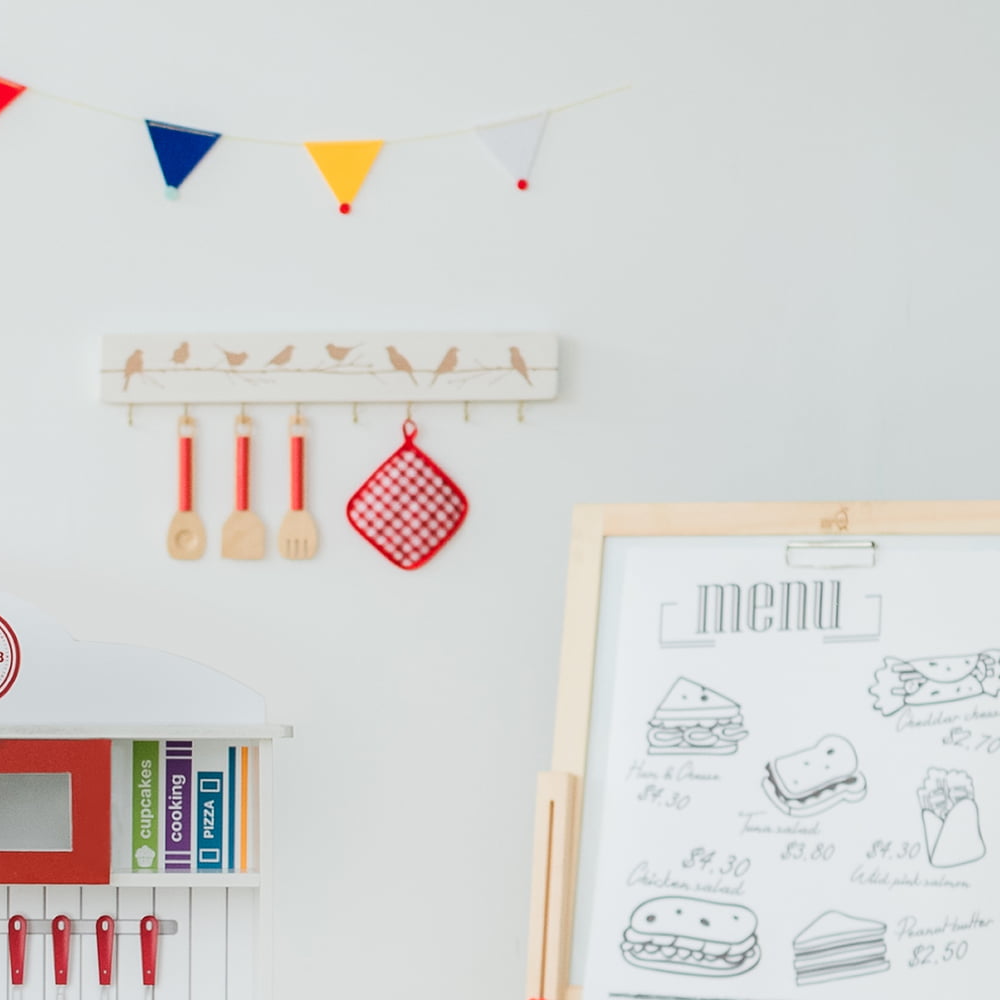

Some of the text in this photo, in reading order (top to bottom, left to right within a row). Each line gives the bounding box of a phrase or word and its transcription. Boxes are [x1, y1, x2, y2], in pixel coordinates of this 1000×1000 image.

[696, 580, 841, 635] menu
[138, 759, 154, 839] cupcakes
[168, 774, 186, 842] cooking
[637, 784, 691, 811] $4.30
[203, 800, 215, 839] PIZZA
[682, 847, 751, 878] $4.30
[780, 841, 836, 861] $3.80
[866, 838, 921, 860] $4.30
[908, 940, 969, 968] $2.50
